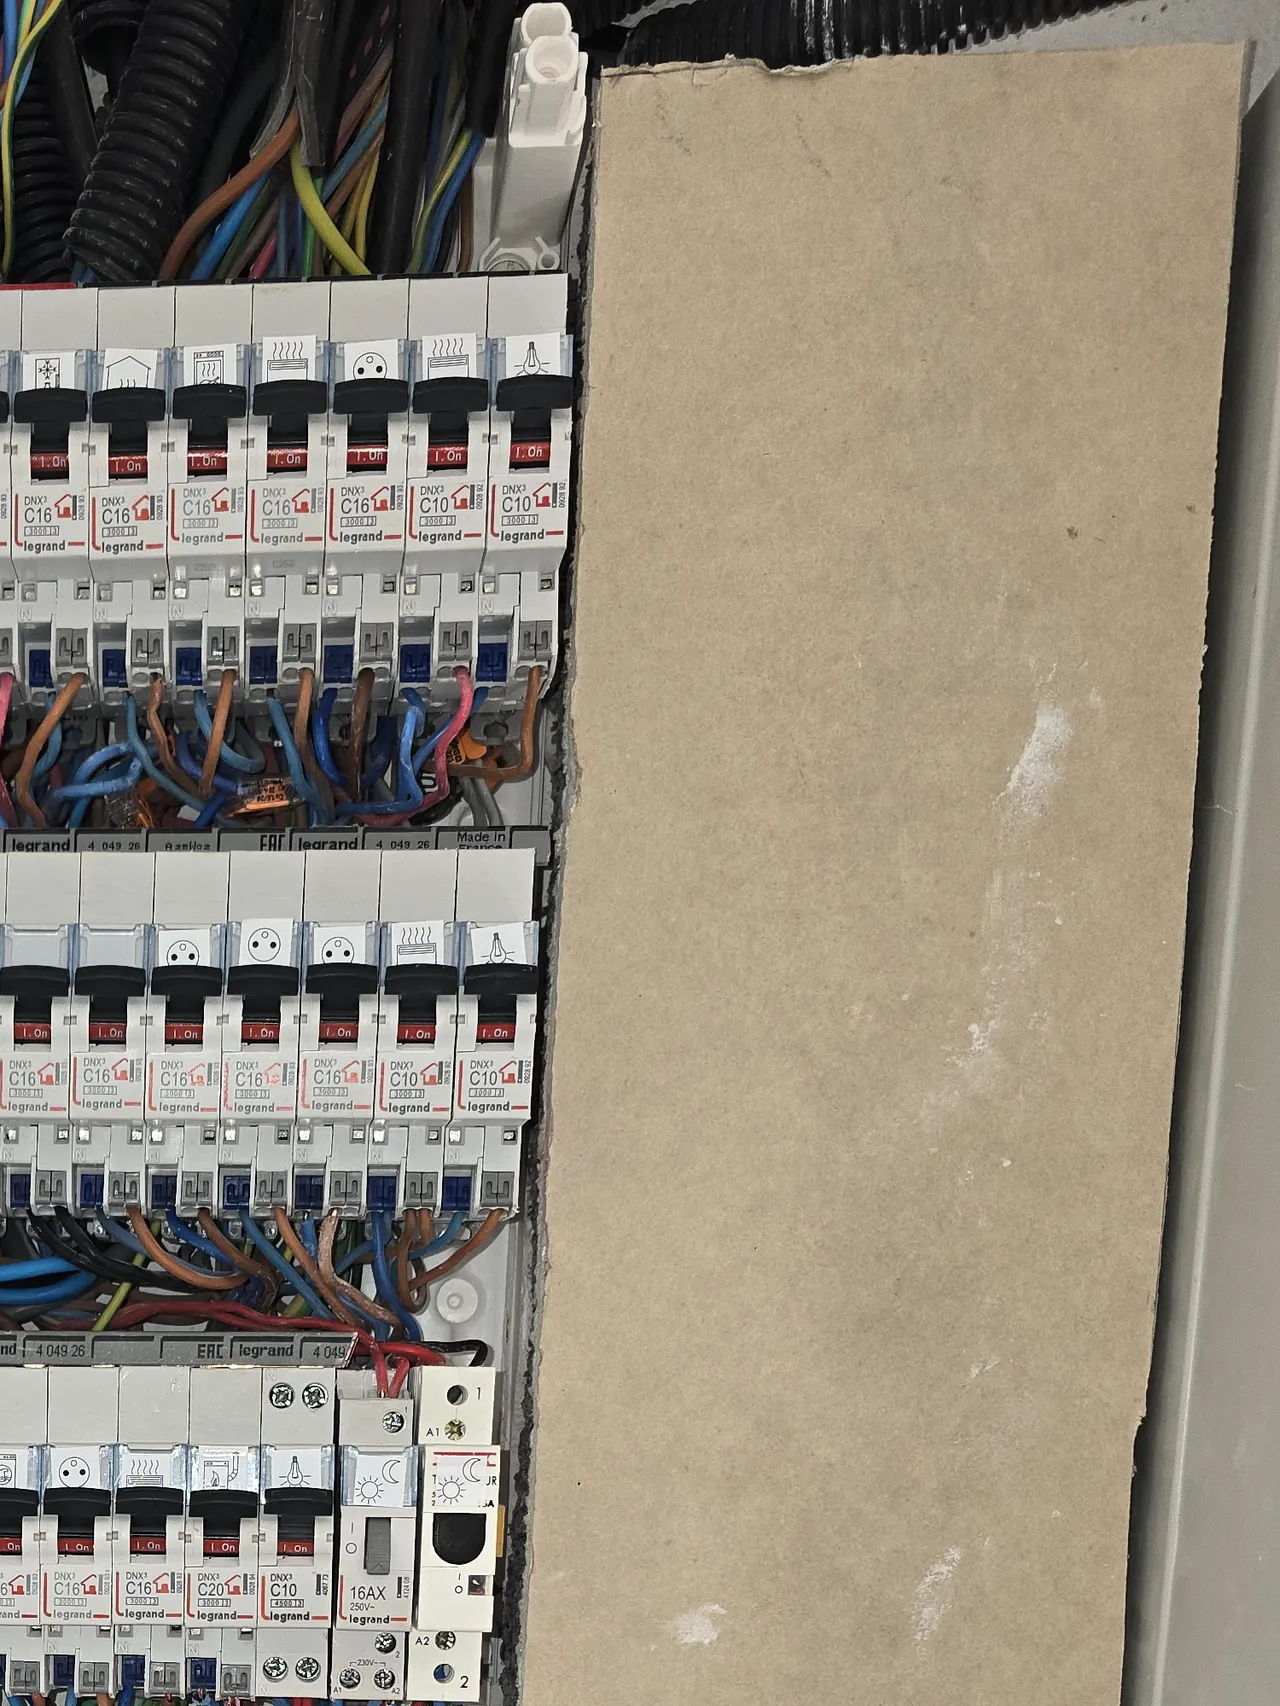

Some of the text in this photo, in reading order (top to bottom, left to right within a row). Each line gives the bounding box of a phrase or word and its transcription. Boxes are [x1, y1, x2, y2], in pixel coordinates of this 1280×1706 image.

[185, 500, 211, 515] C16
[263, 500, 290, 515] C16
[341, 497, 369, 514] C16
[420, 496, 448, 513] C10
[502, 495, 530, 512] C10
[24, 507, 52, 523] C16
[101, 508, 130, 525] C16
[181, 532, 223, 545] legrand
[260, 532, 303, 545] legrand
[339, 530, 383, 544] legrand
[419, 529, 461, 543] legrand
[501, 529, 544, 543] legrand
[23, 539, 65, 552] legrand
[101, 540, 143, 554] legrand
[457, 831, 505, 843] Made in
[8, 1071, 36, 1086] C16
[82, 1068, 110, 1083] C16
[160, 1071, 187, 1086] C16
[235, 1072, 262, 1087] C16
[313, 1069, 340, 1084] C16
[390, 1071, 418, 1087] C10
[469, 1070, 498, 1086] C10
[8, 1102, 48, 1113] legrand
[82, 1099, 122, 1110] legrand
[159, 1101, 200, 1113] legrand
[233, 1102, 274, 1113] legrand
[311, 1100, 353, 1112] legrand
[388, 1102, 430, 1114] legrand
[467, 1101, 510, 1112] legrand
[239, 1343, 293, 1358] legrand
[426, 1427, 439, 1437] A1
[54, 1582, 80, 1596] C16
[126, 1581, 153, 1596] C16
[198, 1583, 225, 1597] C20
[270, 1583, 297, 1597] C10
[350, 1586, 386, 1601] 16AX
[53, 1609, 92, 1620] legrand
[125, 1609, 165, 1620] legrand
[197, 1611, 237, 1621] legrand
[269, 1611, 310, 1622] legrand
[349, 1614, 389, 1625] legrand
[415, 1636, 429, 1646] A2
[460, 1675, 469, 1688] 2
